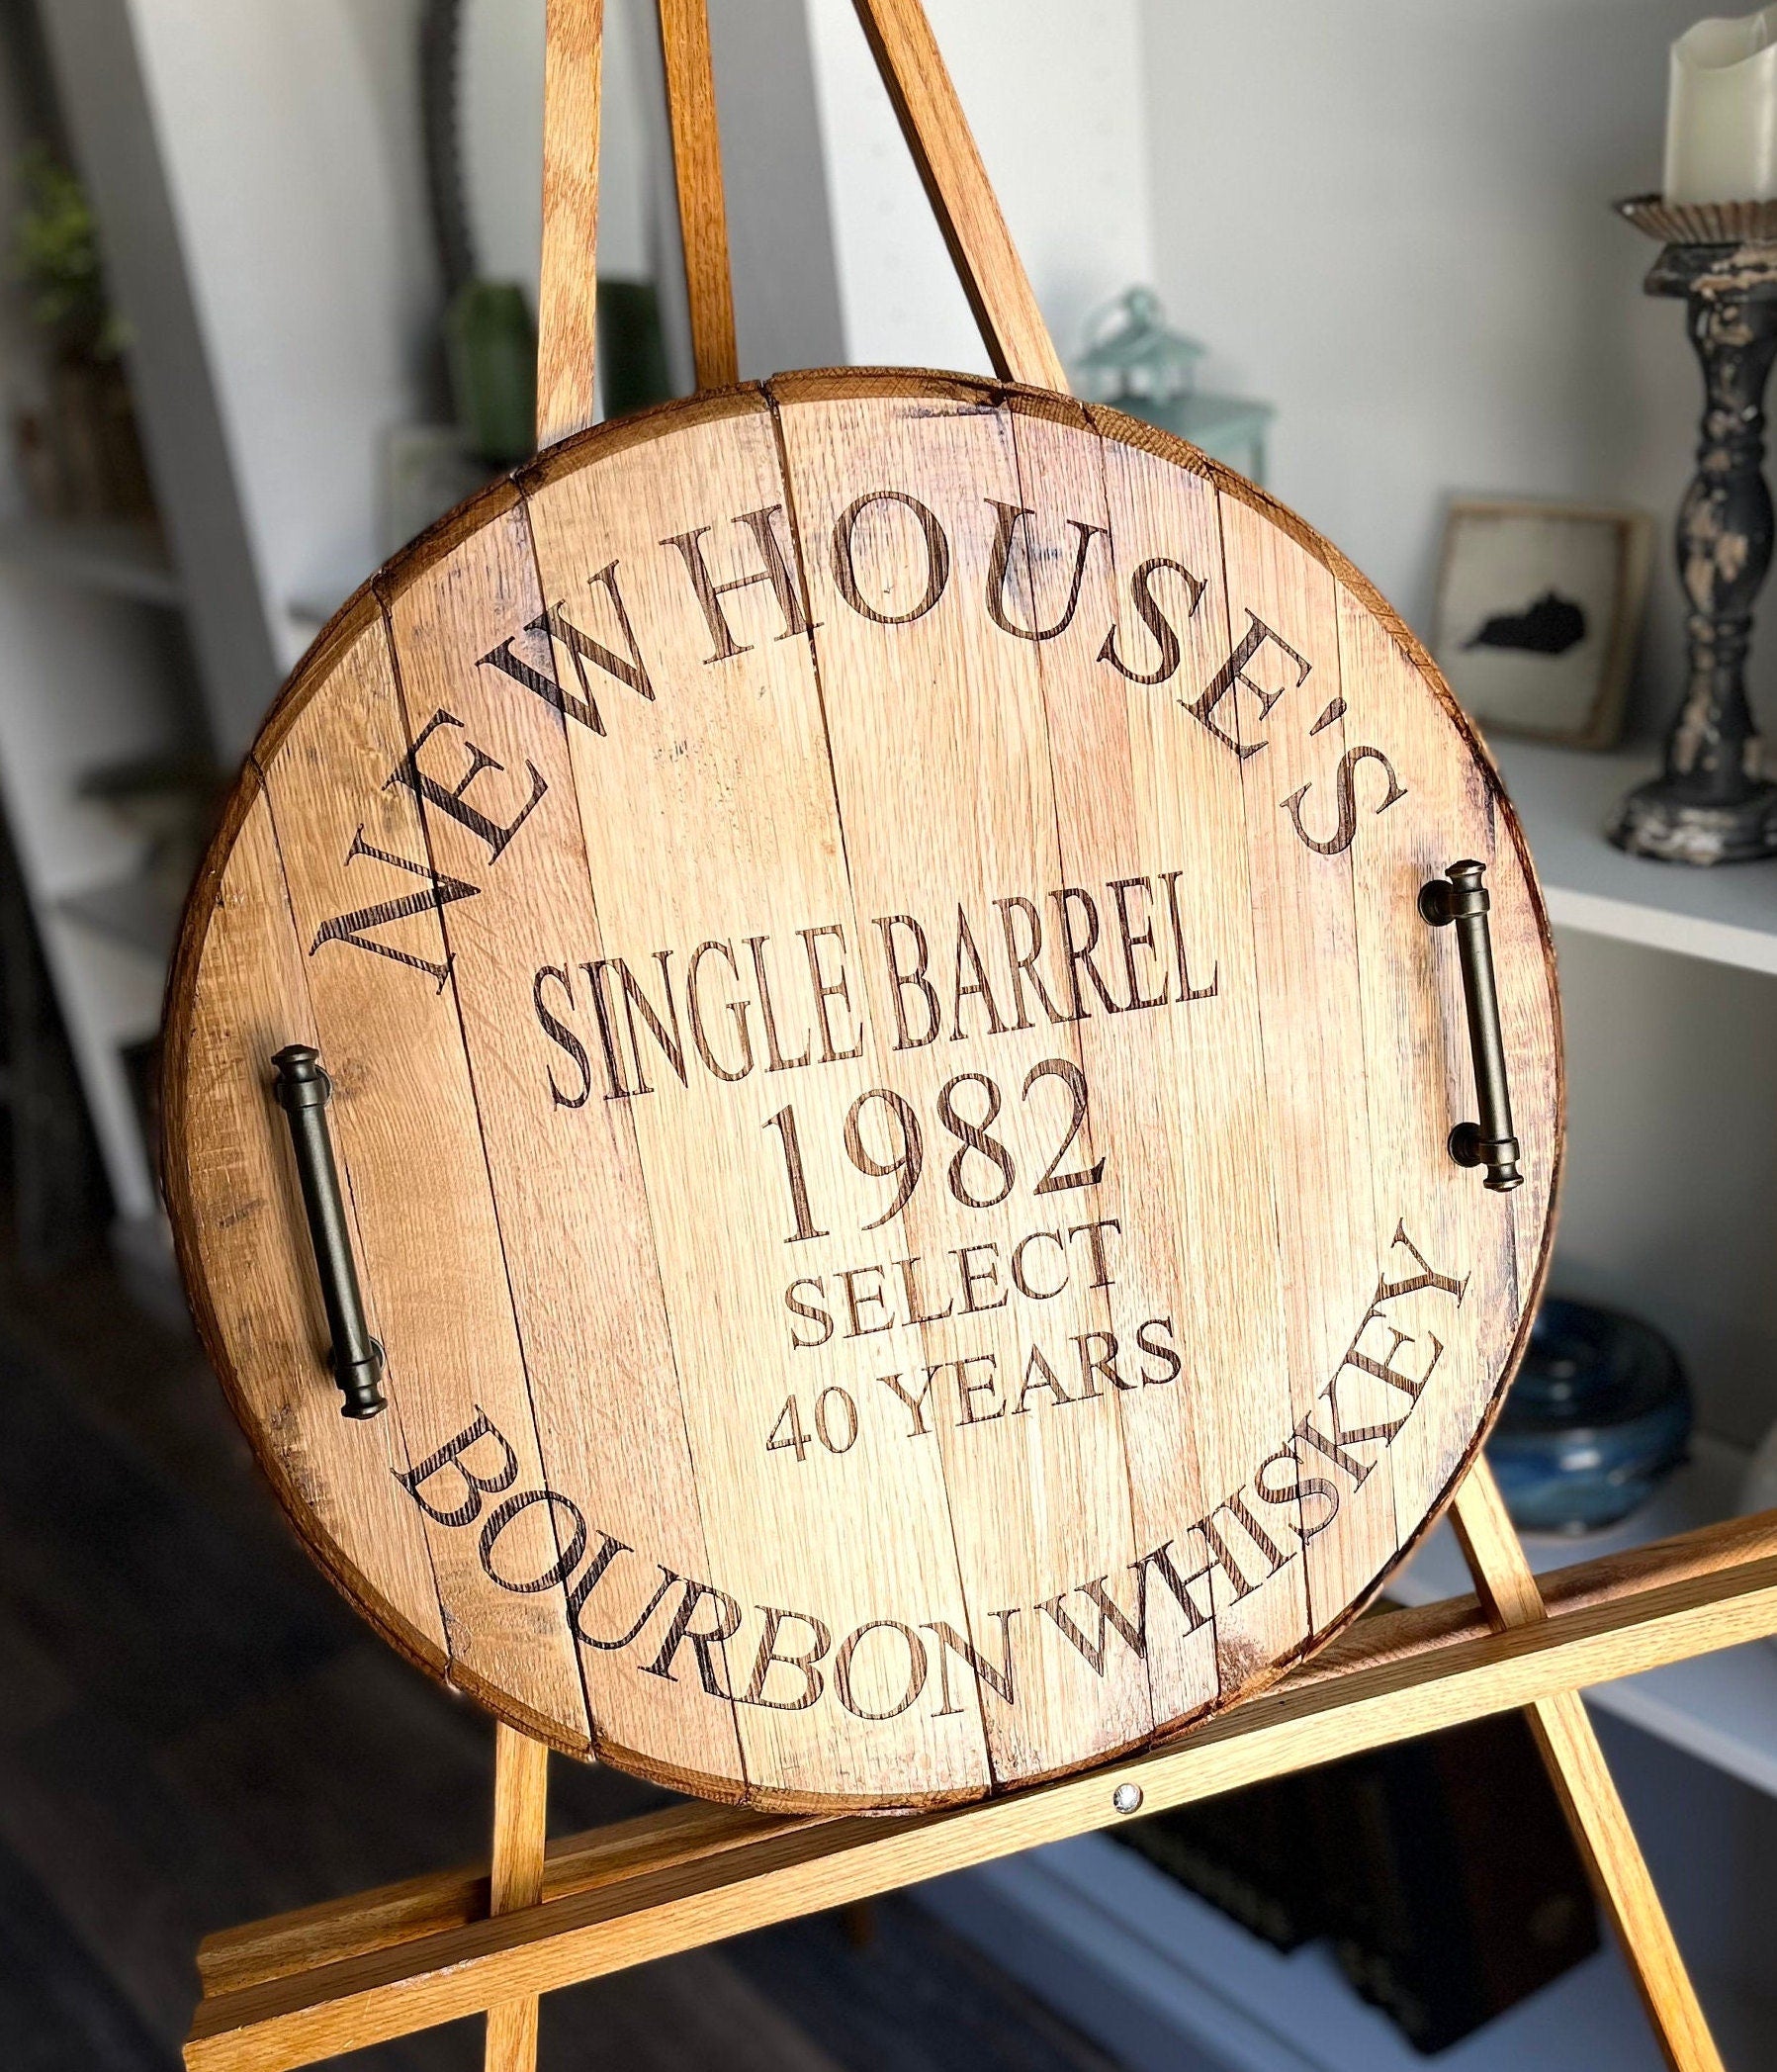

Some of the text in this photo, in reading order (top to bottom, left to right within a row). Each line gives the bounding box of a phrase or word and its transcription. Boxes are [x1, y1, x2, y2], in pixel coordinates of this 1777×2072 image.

[533, 870, 1218, 1112] SINGLE BARREL
[761, 1057, 1107, 1243] 1982
[784, 1218, 1122, 1350] SELECT
[390, 1216, 1472, 1720] BOURBON WHISKEY
[766, 1316, 1182, 1462] 40 YEARS
